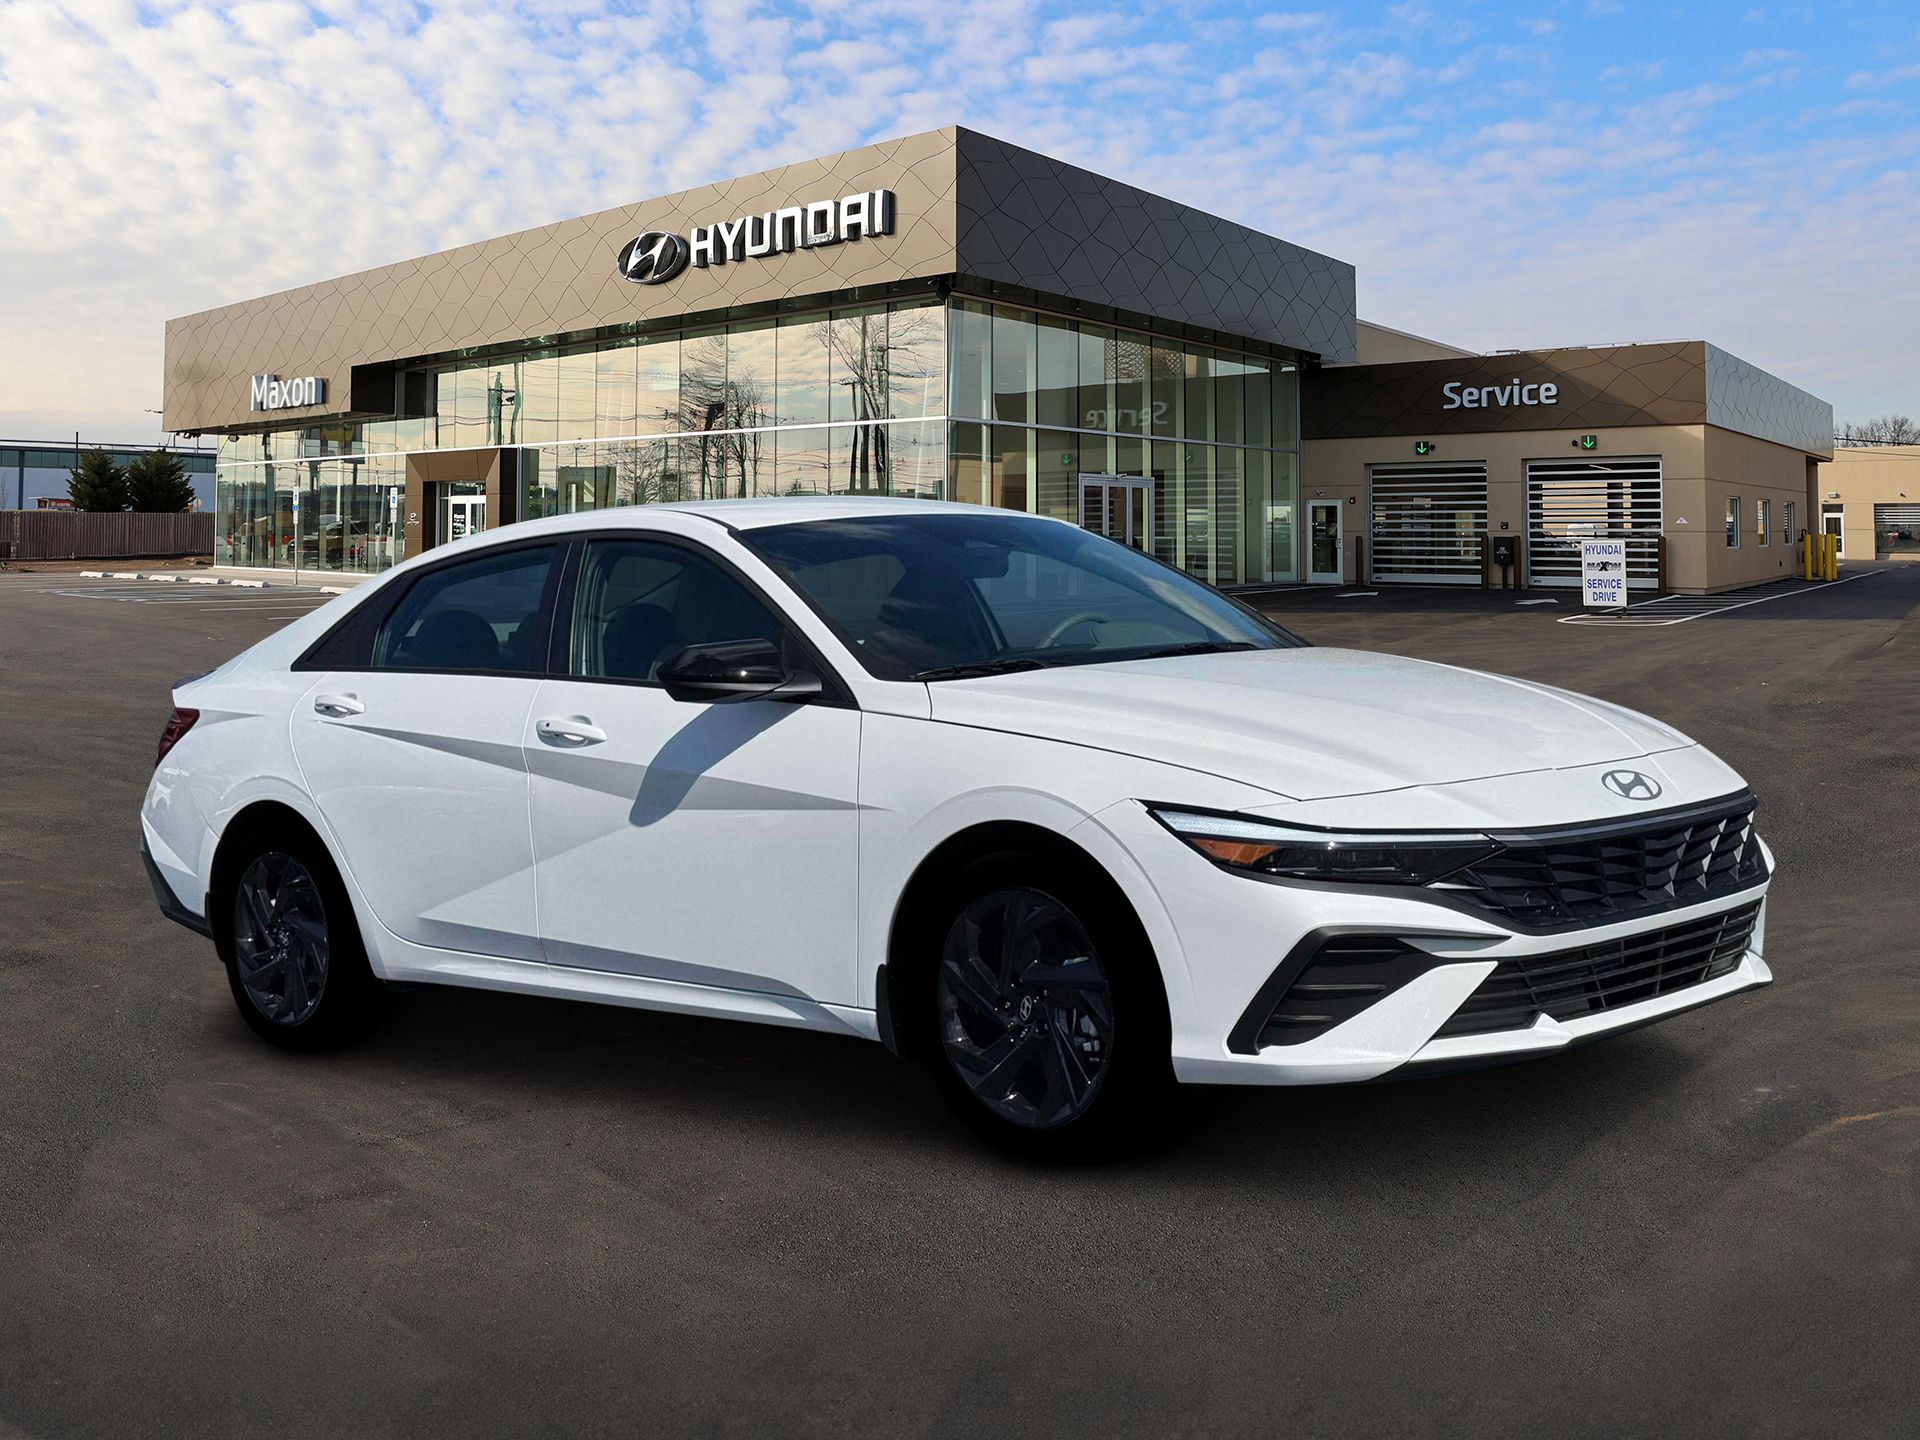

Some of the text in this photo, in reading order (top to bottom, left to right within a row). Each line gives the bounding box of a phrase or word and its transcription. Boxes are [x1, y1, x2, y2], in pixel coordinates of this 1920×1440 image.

[690, 188, 891, 267] HYUNDAI
[250, 374, 322, 411] Maxon
[1442, 377, 1559, 410] Service
[1585, 545, 1622, 555] HYUNDAI
[1586, 561, 1622, 571] MAXON
[1586, 579, 1622, 589] SERVICE
[1592, 592, 1617, 601] DRIVE
